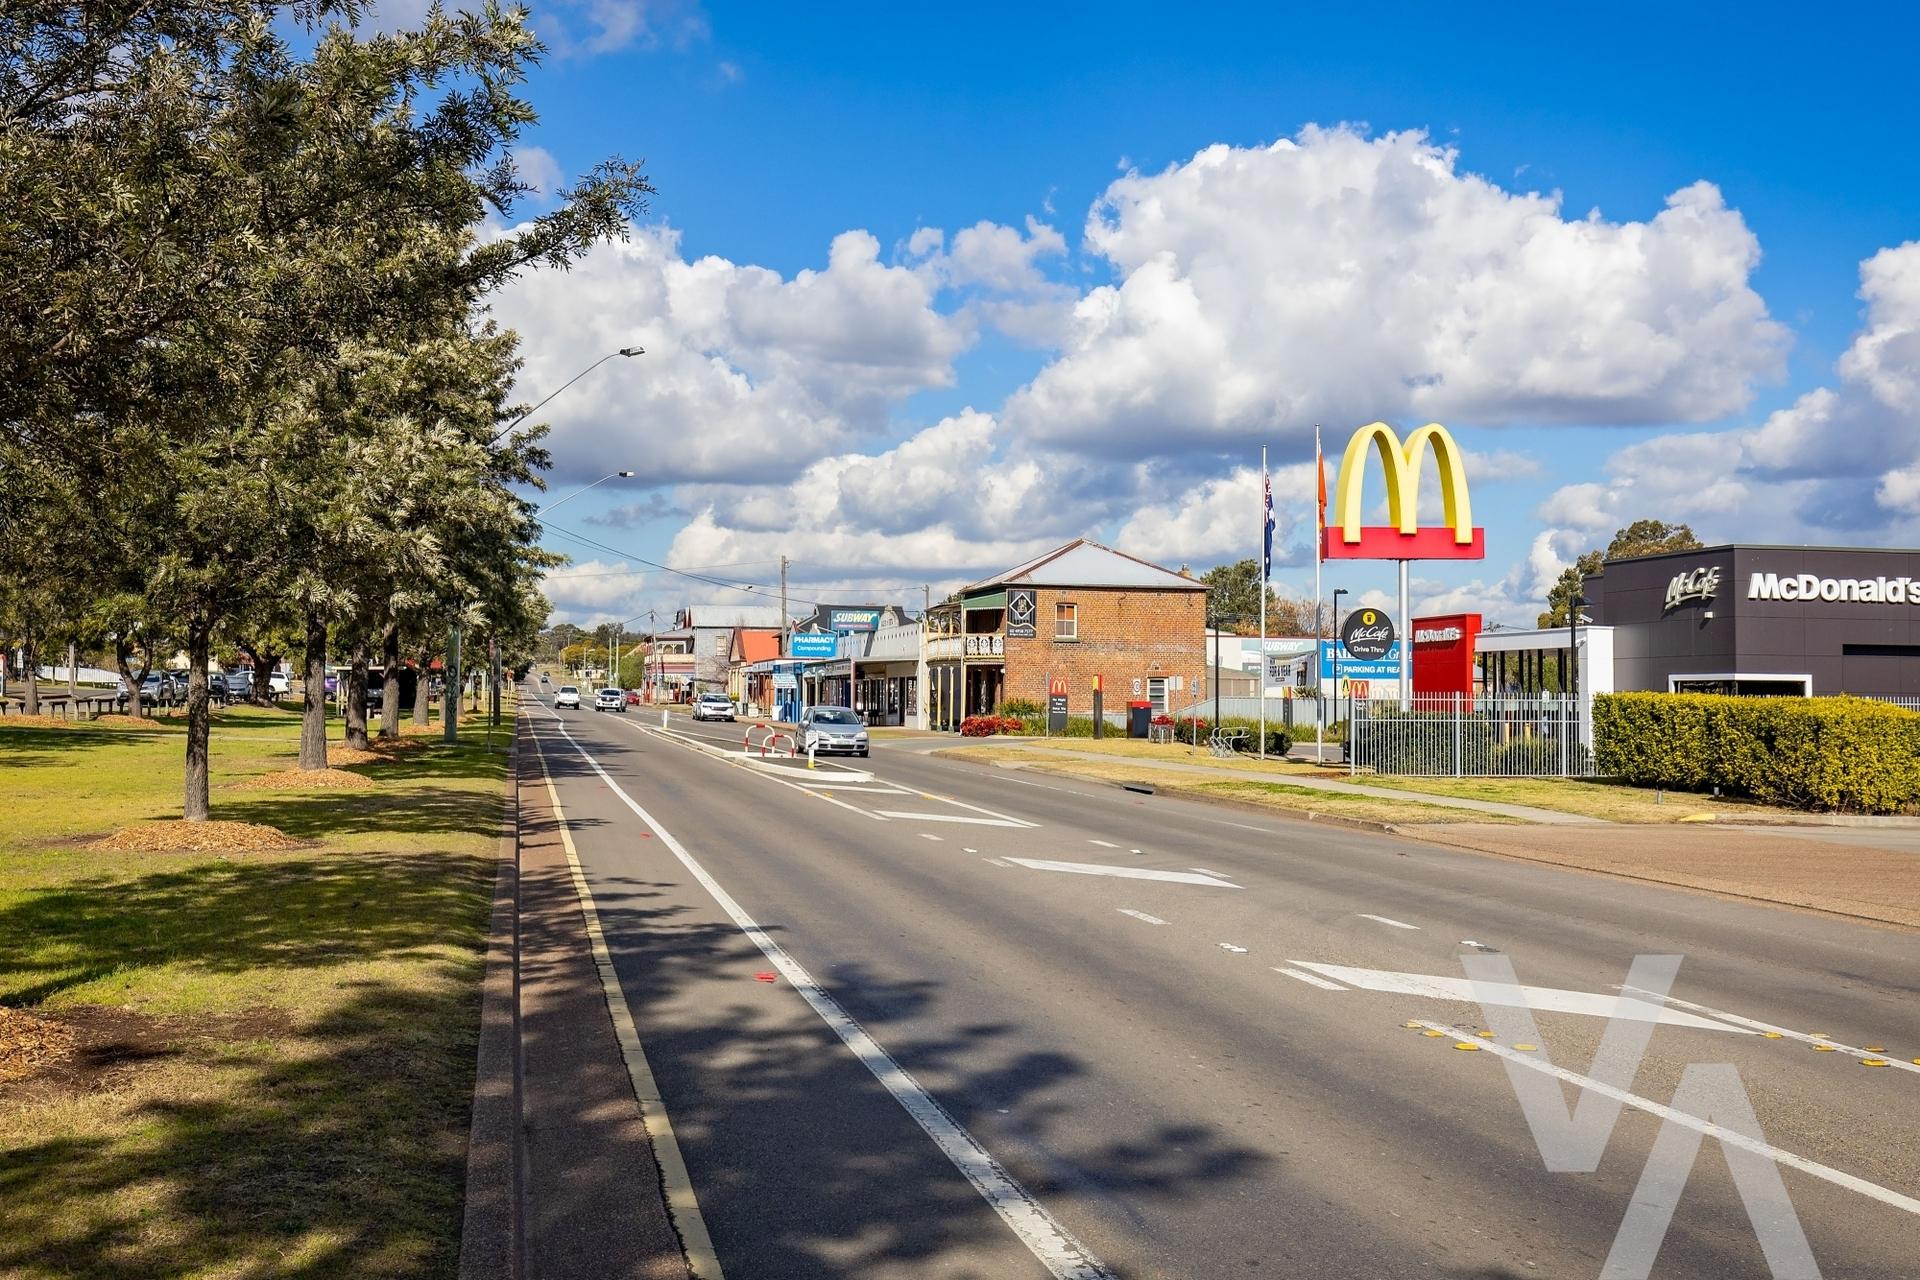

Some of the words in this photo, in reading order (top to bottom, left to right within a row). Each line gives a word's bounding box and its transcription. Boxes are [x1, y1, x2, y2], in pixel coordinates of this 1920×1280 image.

[1748, 573, 1920, 604] McDonald's
[833, 612, 877, 622] SUBWAY
[793, 636, 835, 644] PHARMACY
[1353, 645, 1370, 653] Drive
[1343, 665, 1376, 673] PARKING
[1376, 665, 1386, 673] AT
